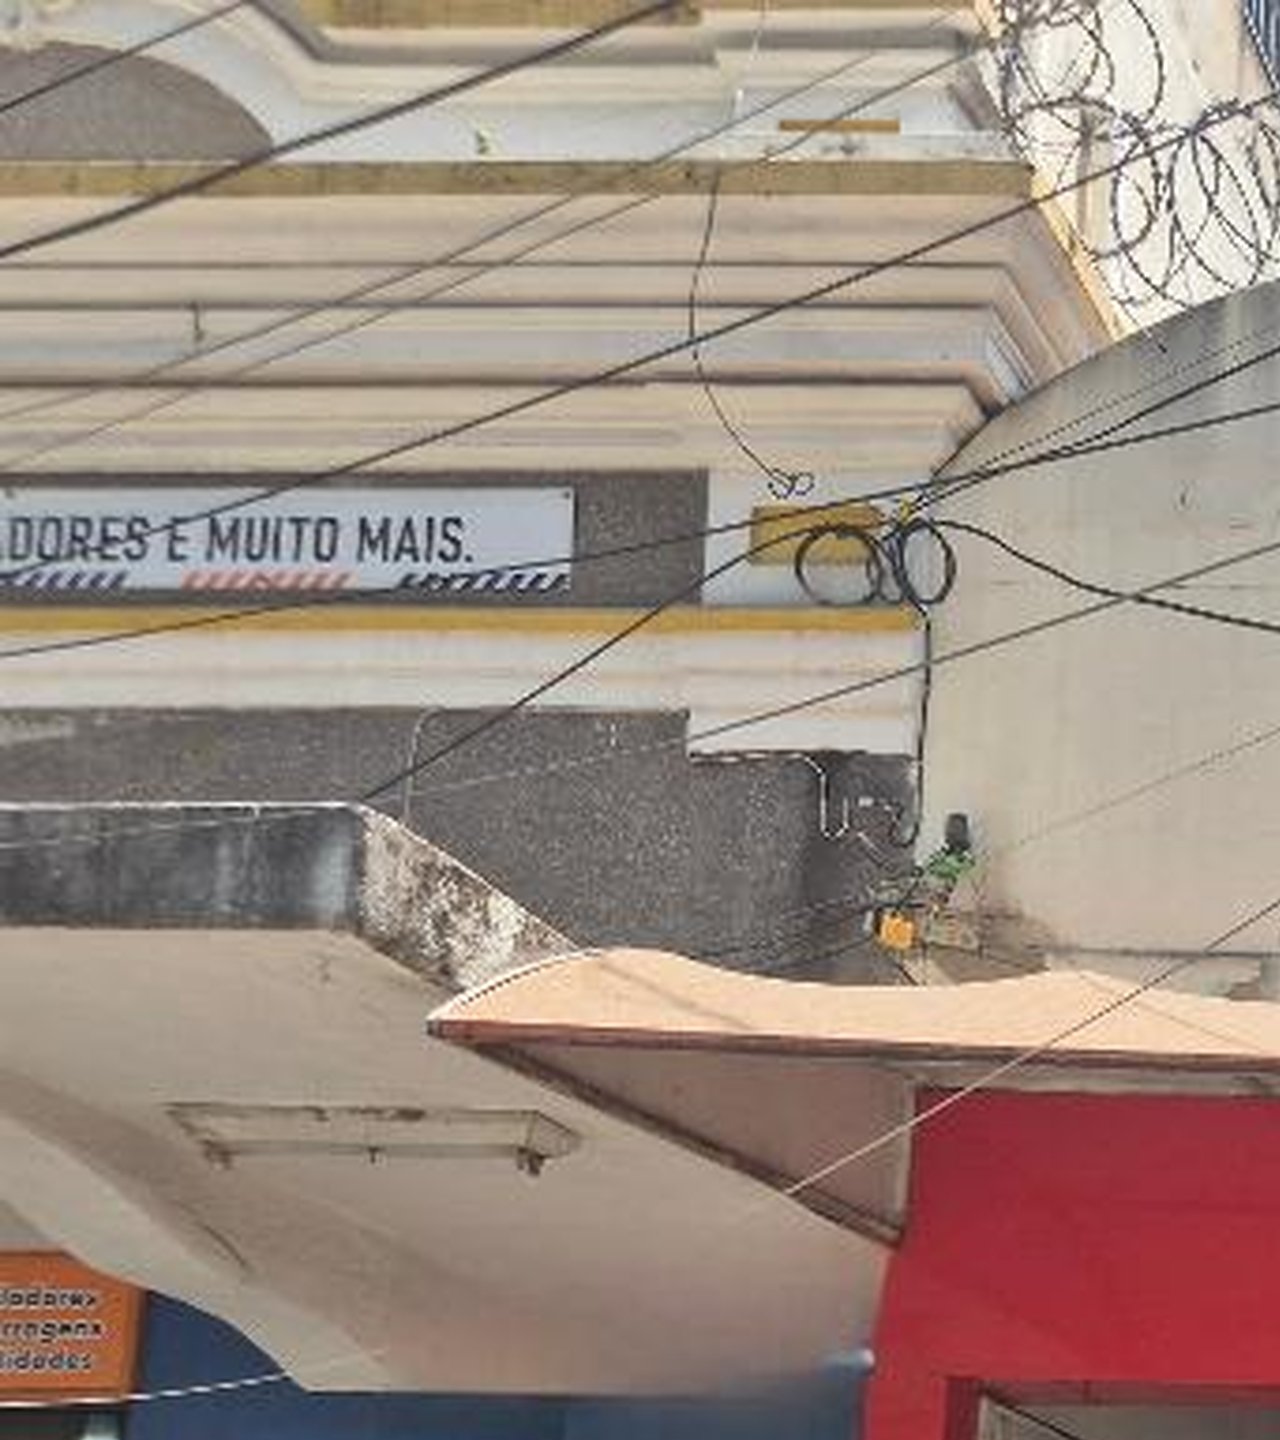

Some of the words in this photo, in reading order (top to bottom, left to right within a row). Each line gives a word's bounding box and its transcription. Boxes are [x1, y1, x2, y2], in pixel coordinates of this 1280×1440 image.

[0, 516, 150, 562] DORES
[168, 516, 189, 562] E
[205, 515, 341, 562] MUITO
[356, 515, 474, 563] MAIS.
